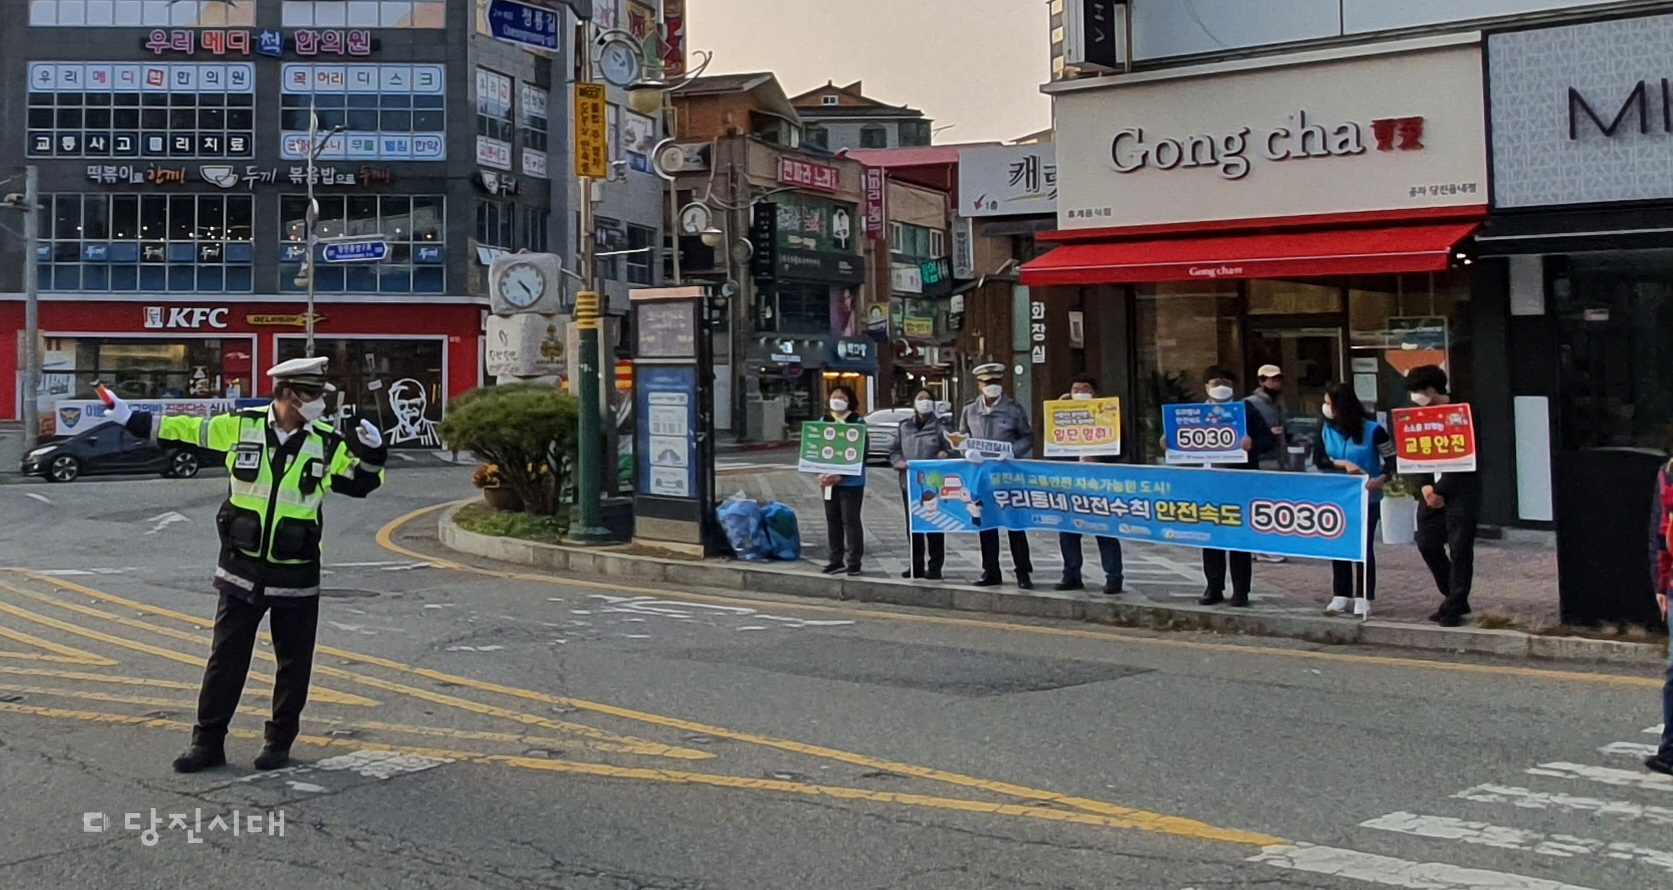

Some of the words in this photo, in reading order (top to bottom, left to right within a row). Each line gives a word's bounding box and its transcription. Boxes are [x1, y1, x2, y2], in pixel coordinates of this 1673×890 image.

[145, 29, 195, 54] 우리
[200, 29, 250, 55] 메디
[294, 29, 371, 55] 한의원
[35, 136, 131, 151] 교통사고
[1110, 128, 1251, 180] Gong
[1265, 108, 1367, 163] cha
[87, 165, 144, 183] 떡볶이로
[242, 165, 277, 189] 두끼
[166, 307, 229, 328] KFC
[1031, 302, 1046, 364] 화장실
[1053, 428, 1079, 442] 일단
[1178, 429, 1235, 447] 5030
[1404, 434, 1465, 454] 교통안전
[1074, 476, 1137, 493] 지속가능한
[1140, 482, 1171, 494] 도시!
[992, 490, 1068, 511] 우리동네
[1071, 494, 1149, 518] 안전수칙
[1154, 500, 1241, 525] 안전속도
[1252, 501, 1340, 534] 5030
